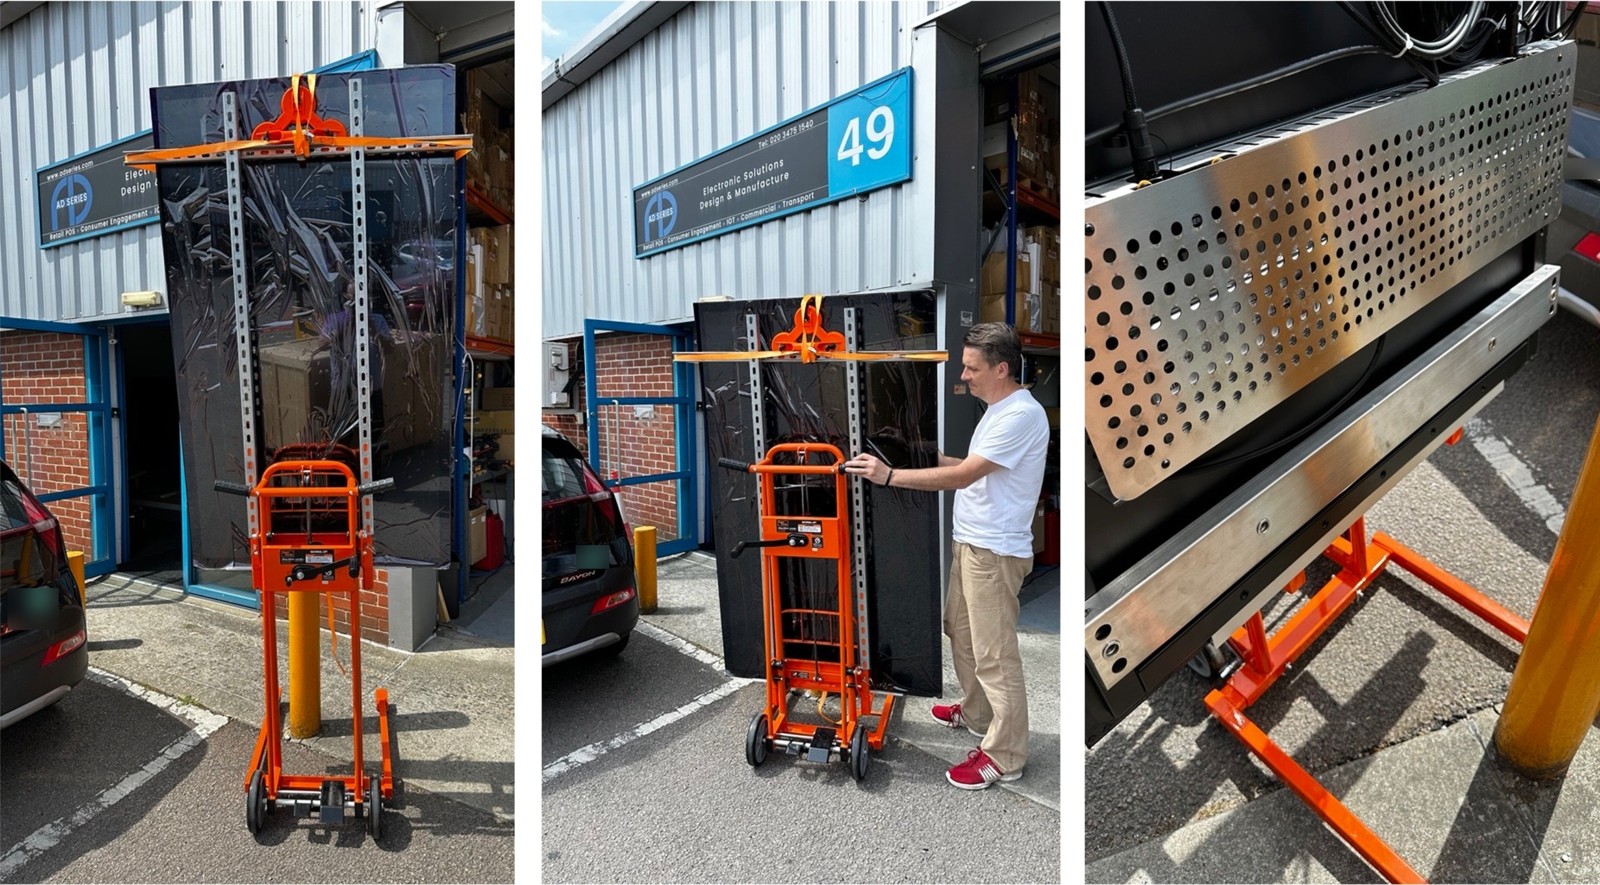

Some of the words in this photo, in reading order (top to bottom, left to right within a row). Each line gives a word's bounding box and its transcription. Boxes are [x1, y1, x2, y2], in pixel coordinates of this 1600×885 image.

[758, 139, 769, 149] Tel:
[770, 133, 781, 144] 020
[782, 126, 798, 139] 3475
[798, 119, 814, 132] 1540
[837, 105, 895, 167] 49
[46, 160, 94, 181] www.adseries.com
[702, 175, 741, 196] Electronic
[743, 159, 784, 181] Solutions
[56, 200, 66, 209] AD
[66, 192, 88, 207] SERIES
[120, 181, 151, 197] Design
[641, 178, 679, 198] www.adseries.com
[699, 194, 725, 210] Design
[726, 191, 733, 201] &
[734, 171, 790, 198] Manufacture
[49, 231, 65, 240] Retail
[65, 228, 76, 237] POS
[80, 219, 109, 233] Consumer
[109, 210, 148, 225] Engagement
[648, 214, 656, 224] AD
[656, 207, 674, 220] SERIES
[667, 231, 691, 243] Consumer
[690, 223, 722, 237] Engagement
[726, 216, 736, 225] IOT
[740, 203, 777, 221] Commercial
[782, 191, 815, 208] Transport
[560, 570, 596, 584] BAYON
